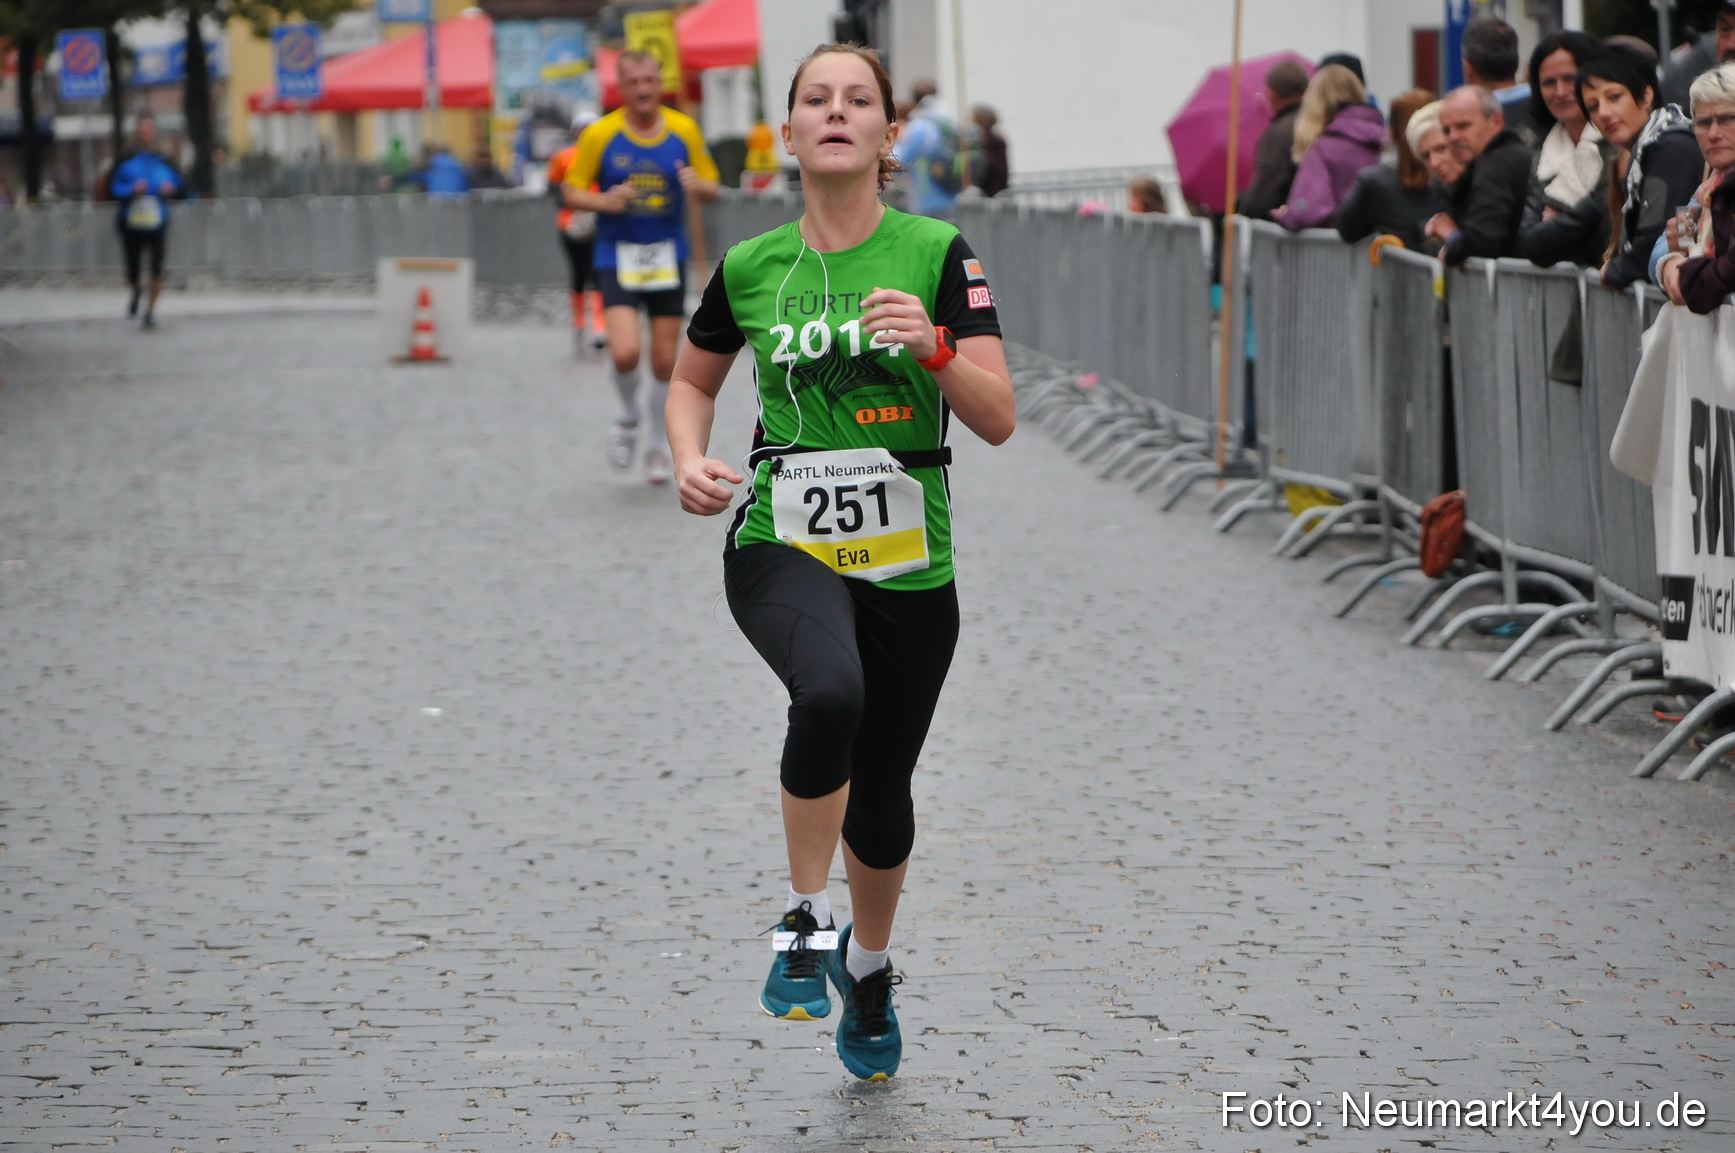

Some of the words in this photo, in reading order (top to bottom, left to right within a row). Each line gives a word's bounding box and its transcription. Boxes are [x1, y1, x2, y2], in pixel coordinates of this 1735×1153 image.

[970, 289, 989, 305] DB
[769, 319, 906, 364] 2014
[854, 405, 916, 425] OBI
[775, 466, 822, 482] PARTL
[825, 462, 895, 478] Neumarkt
[803, 481, 890, 536] 251
[836, 547, 871, 568] Eva
